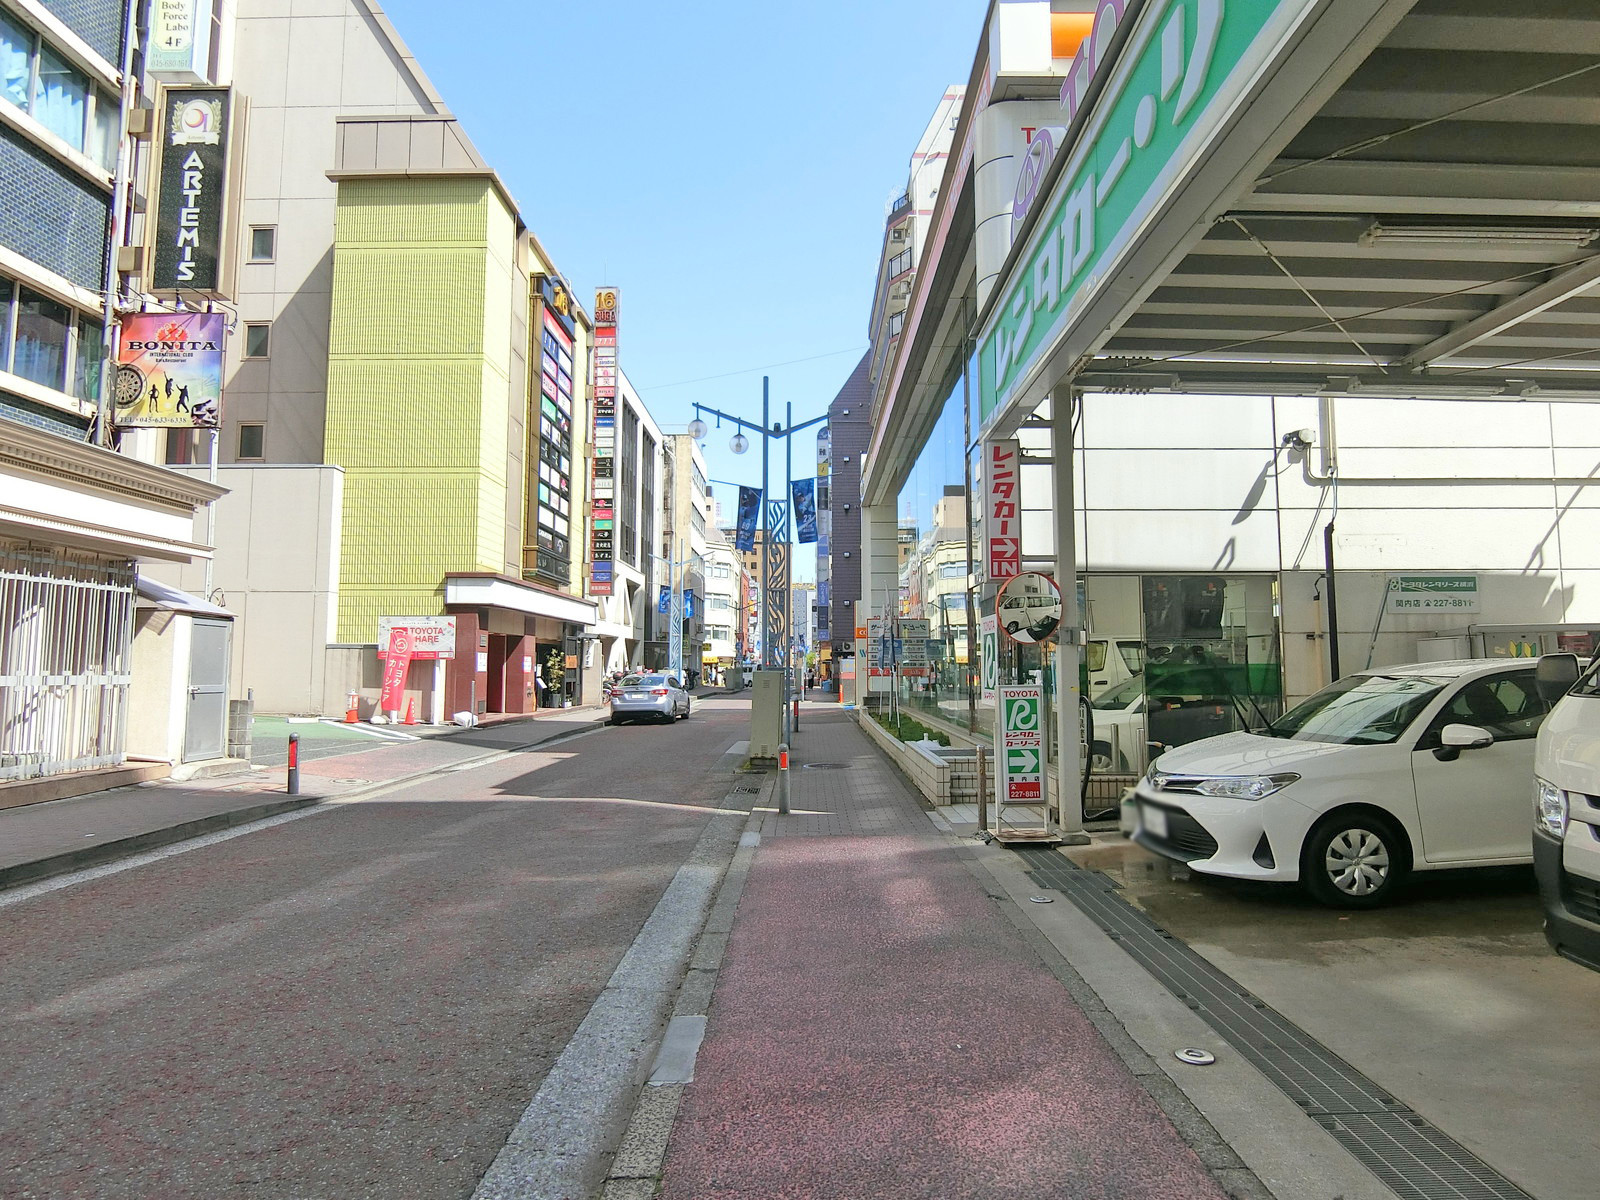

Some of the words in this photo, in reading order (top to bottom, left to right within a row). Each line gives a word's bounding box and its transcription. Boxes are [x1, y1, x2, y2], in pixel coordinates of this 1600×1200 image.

[161, 1, 185, 12] Body
[163, 12, 188, 20] Force
[166, 23, 189, 31] Labo
[176, 150, 205, 281] ARTEMIS
[128, 341, 219, 351] BONITA
[992, 446, 1015, 535] レンタカー
[993, 561, 1018, 576] IN
[409, 627, 444, 635] TOYOTA
[414, 635, 440, 643] HARE
[393, 660, 405, 687] トヨタ
[381, 659, 397, 702] カーシェア
[1004, 690, 1040, 698] TOYOTA
[1010, 790, 1040, 798] 227-8811
